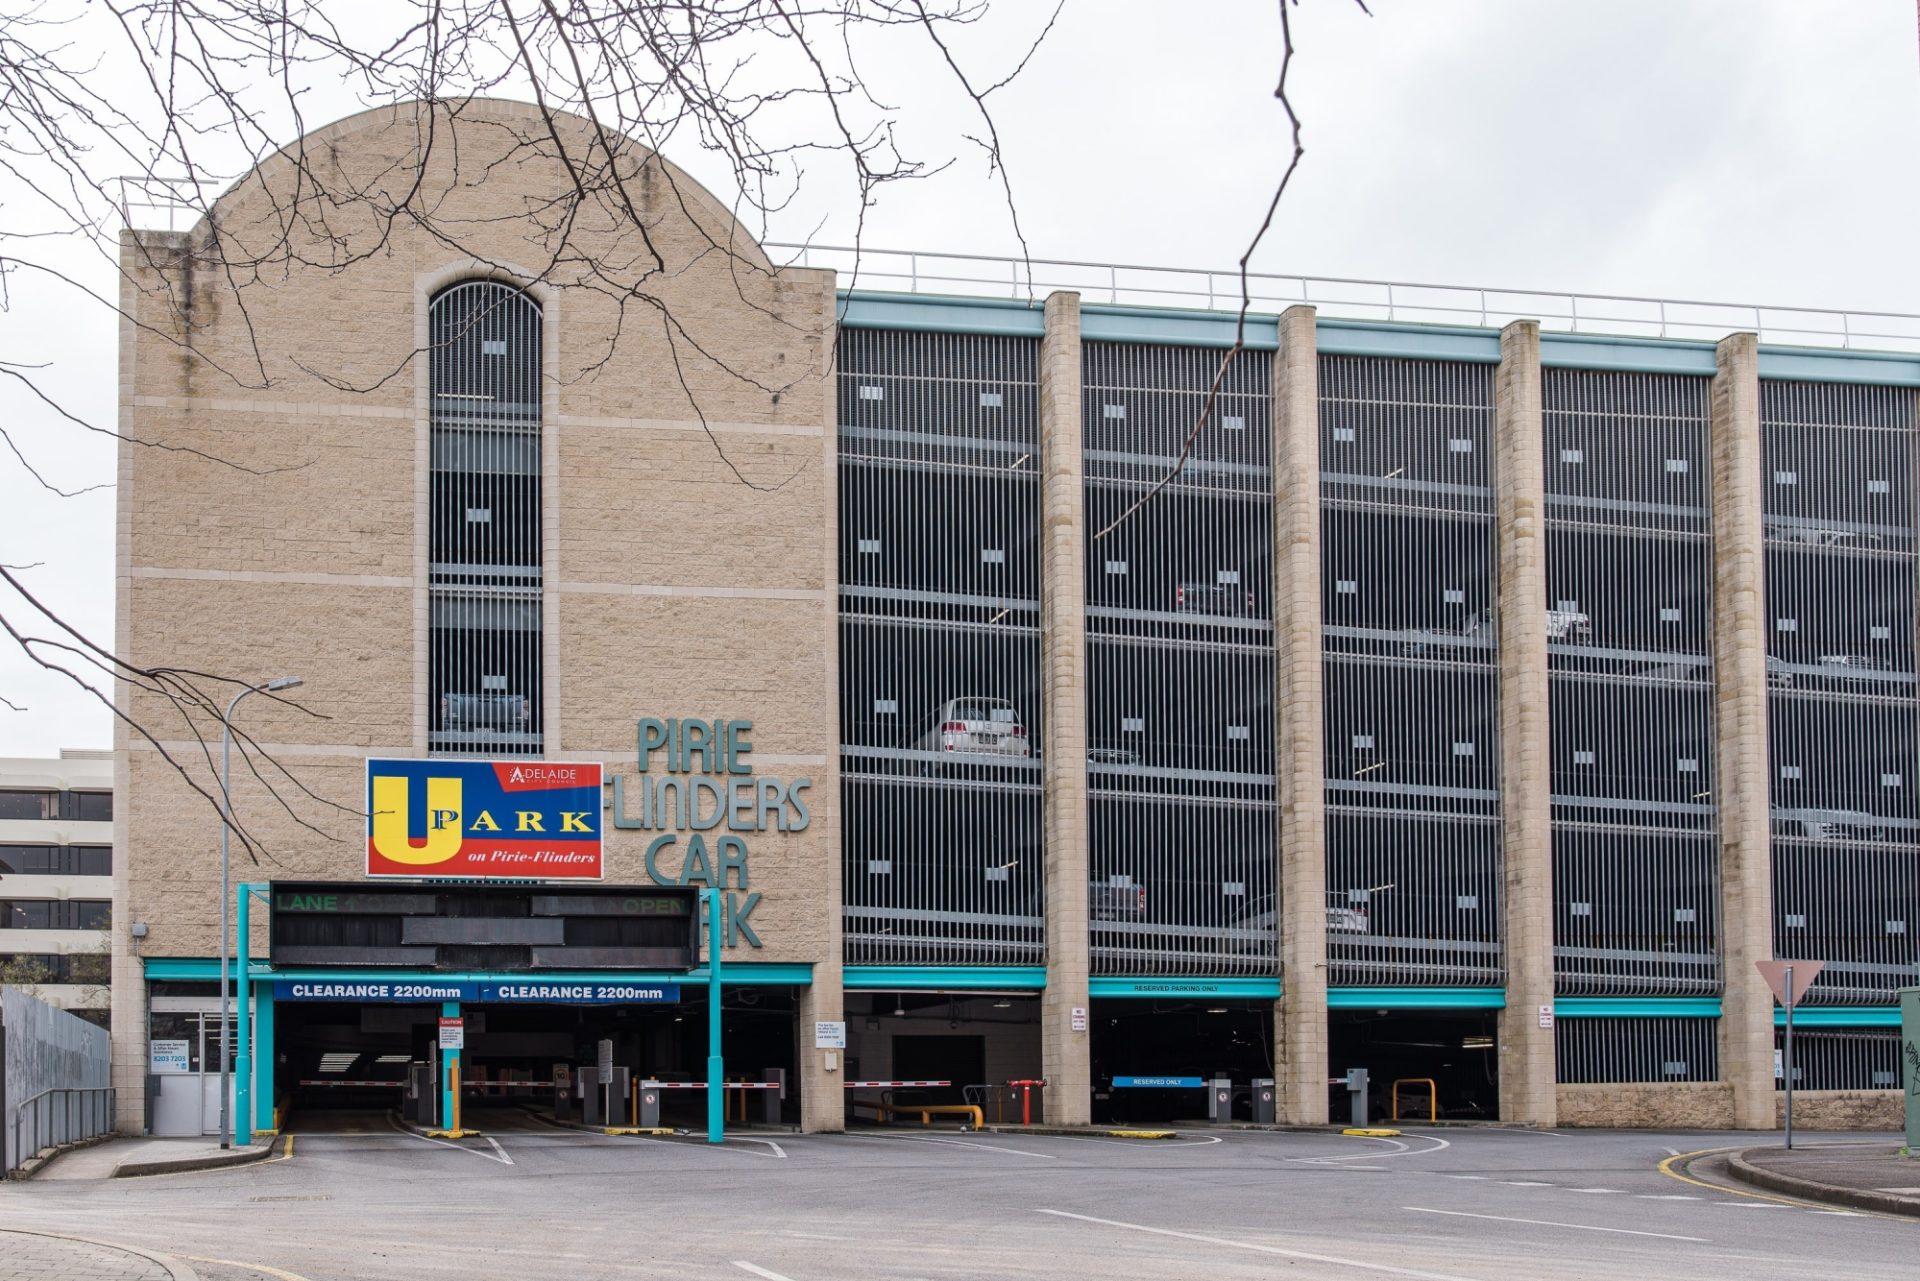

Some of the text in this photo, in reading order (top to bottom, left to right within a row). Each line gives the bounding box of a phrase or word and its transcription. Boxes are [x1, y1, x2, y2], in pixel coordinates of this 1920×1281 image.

[638, 717, 752, 773] PIRIE
[510, 766, 576, 783] ADELAIDE
[468, 850, 595, 863] on Pirie-Flinders
[645, 833, 749, 889] CAR
[276, 895, 337, 911] LANE
[623, 899, 685, 914] OPEN
[292, 985, 461, 998] CLEARANCE 2200mm
[498, 986, 663, 999] CLEARANCE 2200mm
